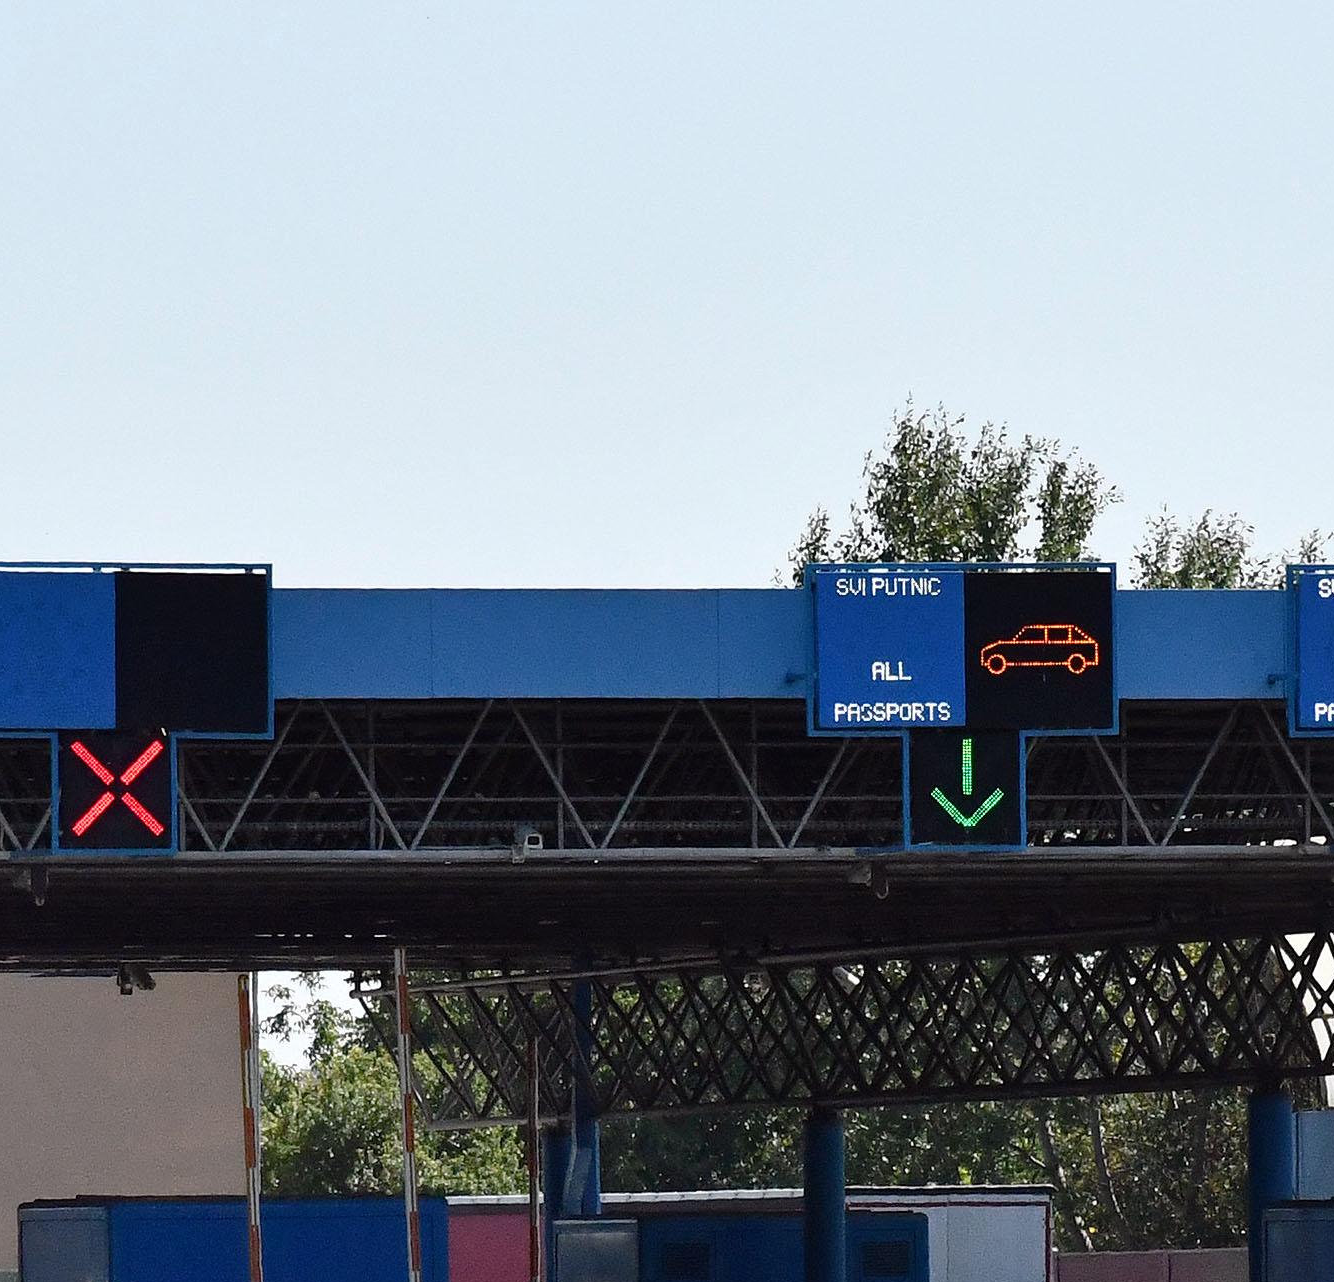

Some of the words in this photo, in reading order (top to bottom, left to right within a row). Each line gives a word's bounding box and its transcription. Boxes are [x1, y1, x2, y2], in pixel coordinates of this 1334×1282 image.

[836, 577, 866, 596] SVI
[871, 661, 912, 681] ALL
[834, 702, 951, 722] PASSPORTS
